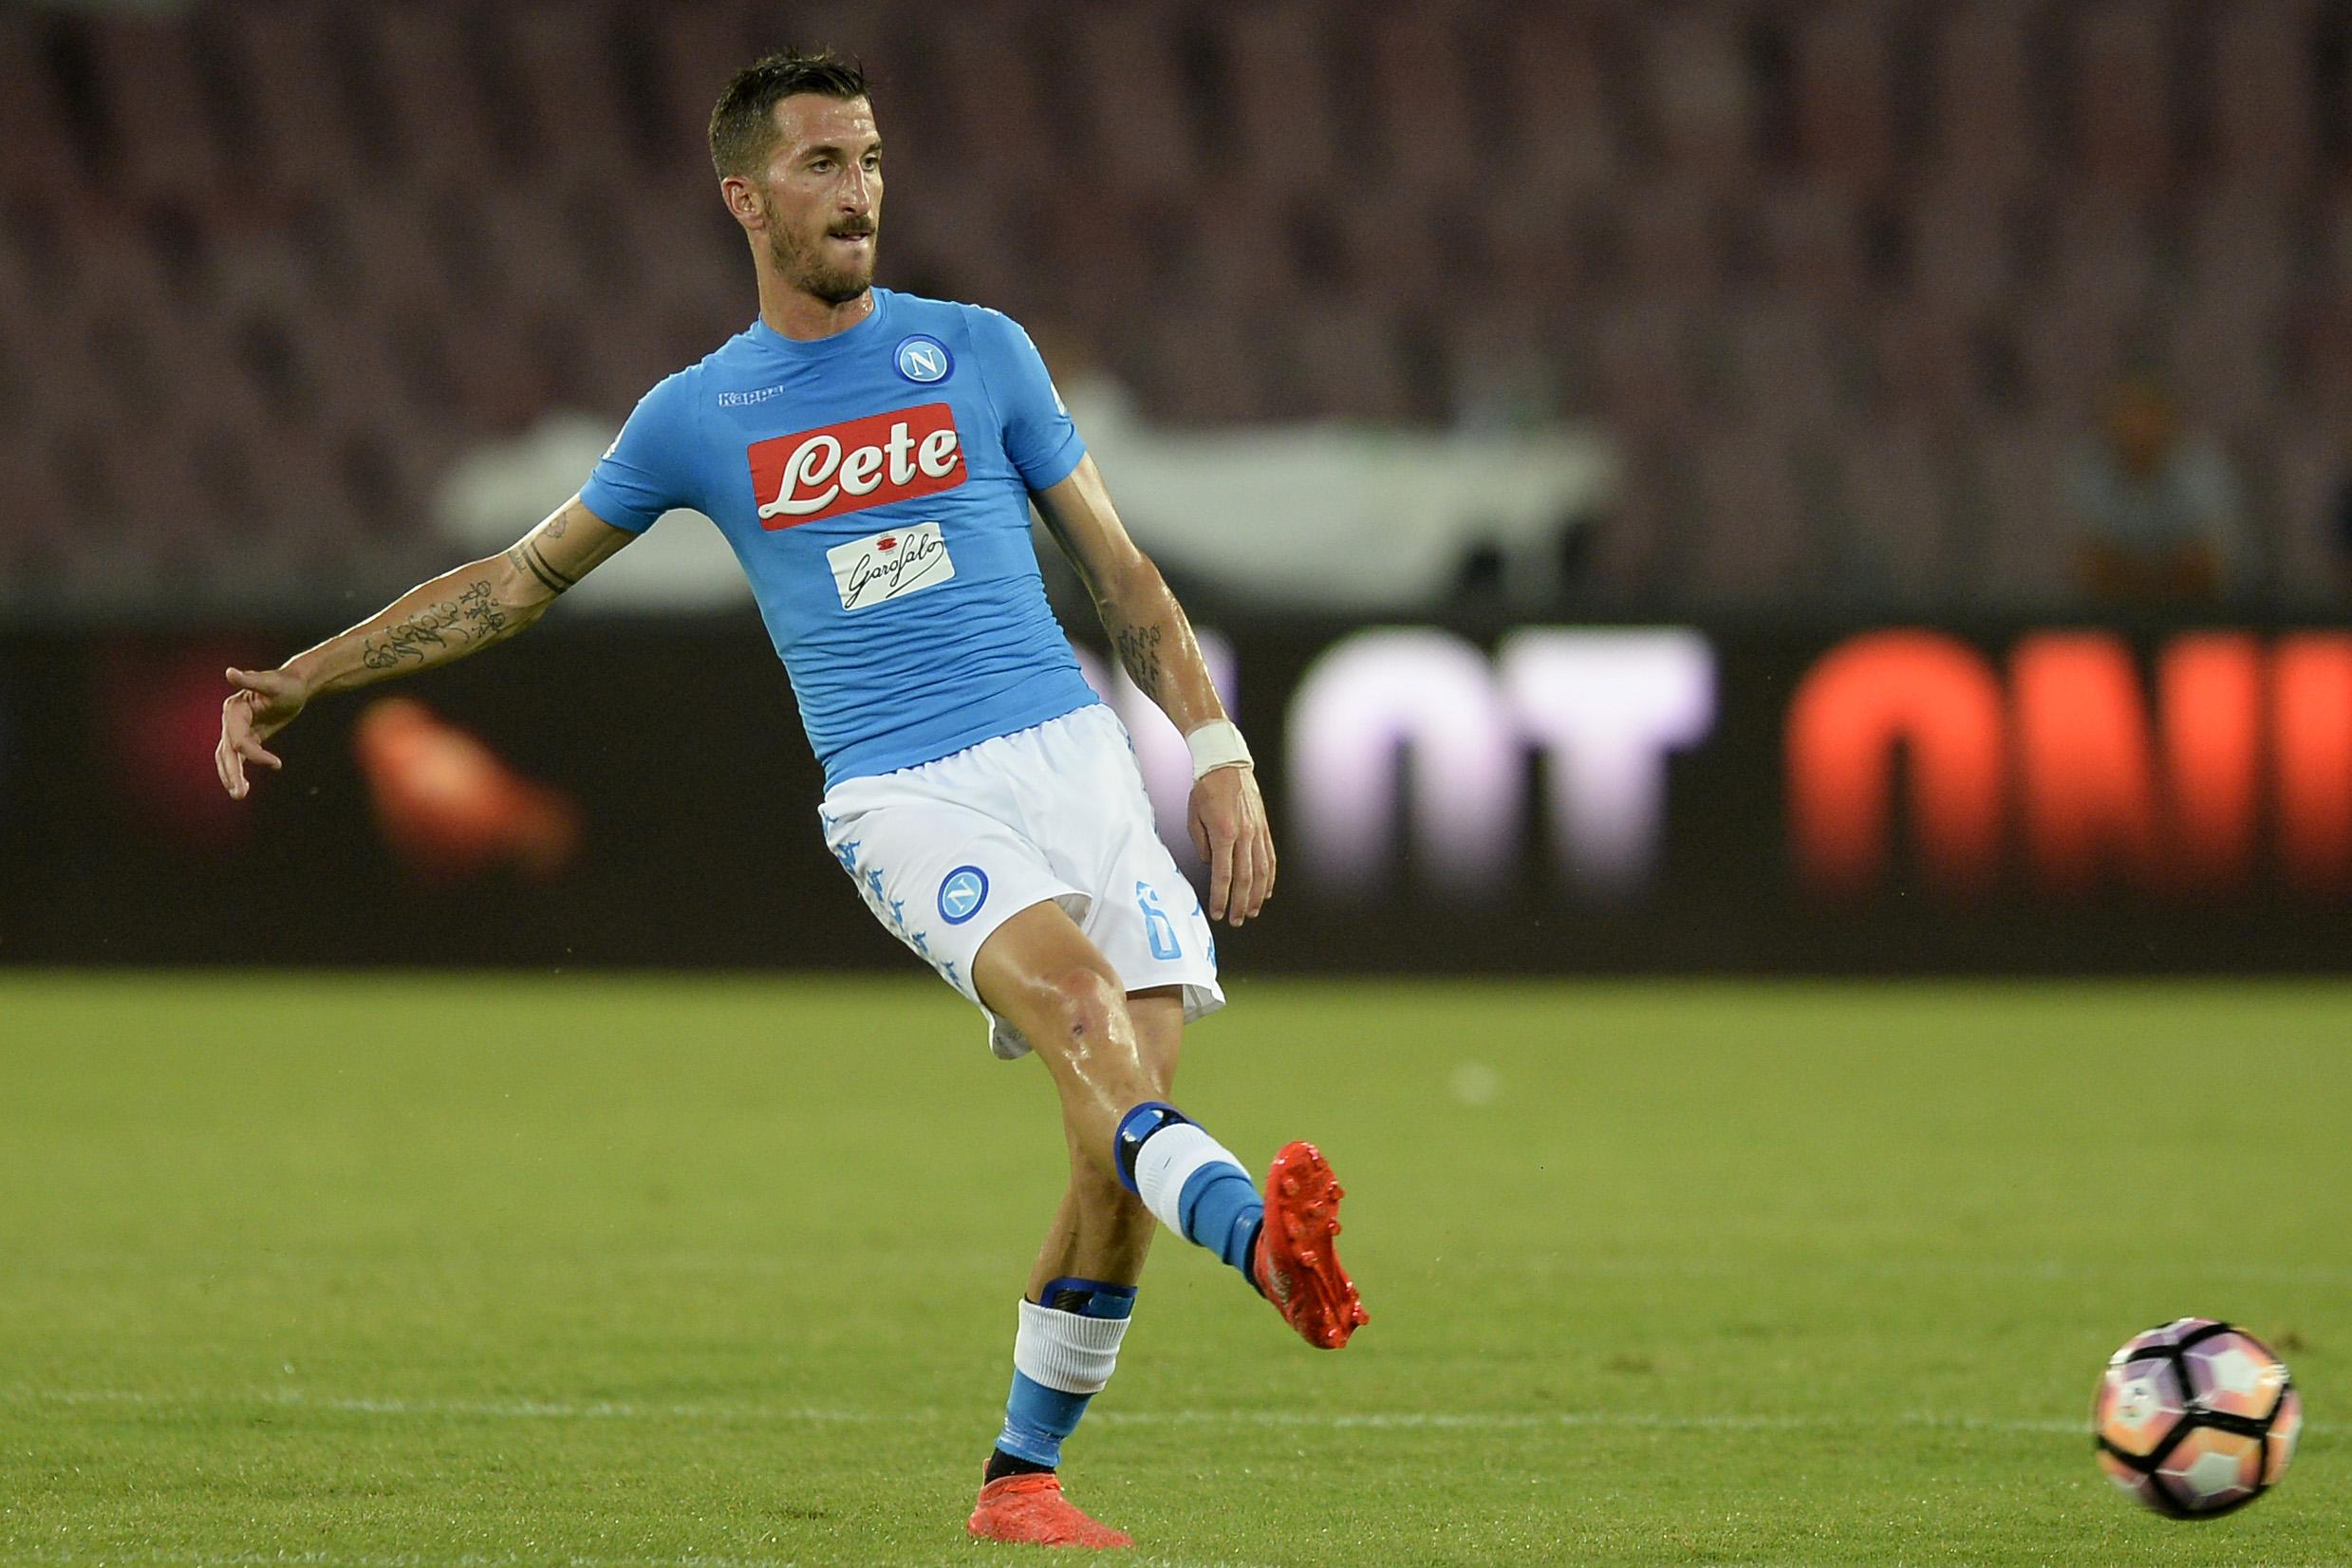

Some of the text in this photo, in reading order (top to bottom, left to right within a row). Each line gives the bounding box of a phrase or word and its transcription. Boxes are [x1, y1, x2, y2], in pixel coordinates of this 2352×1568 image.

[719, 384, 784, 406] Kappa
[907, 349, 939, 377] N
[758, 422, 959, 519] Lete
[845, 533, 943, 608] Garofalo
[1136, 880, 1182, 960] 6
